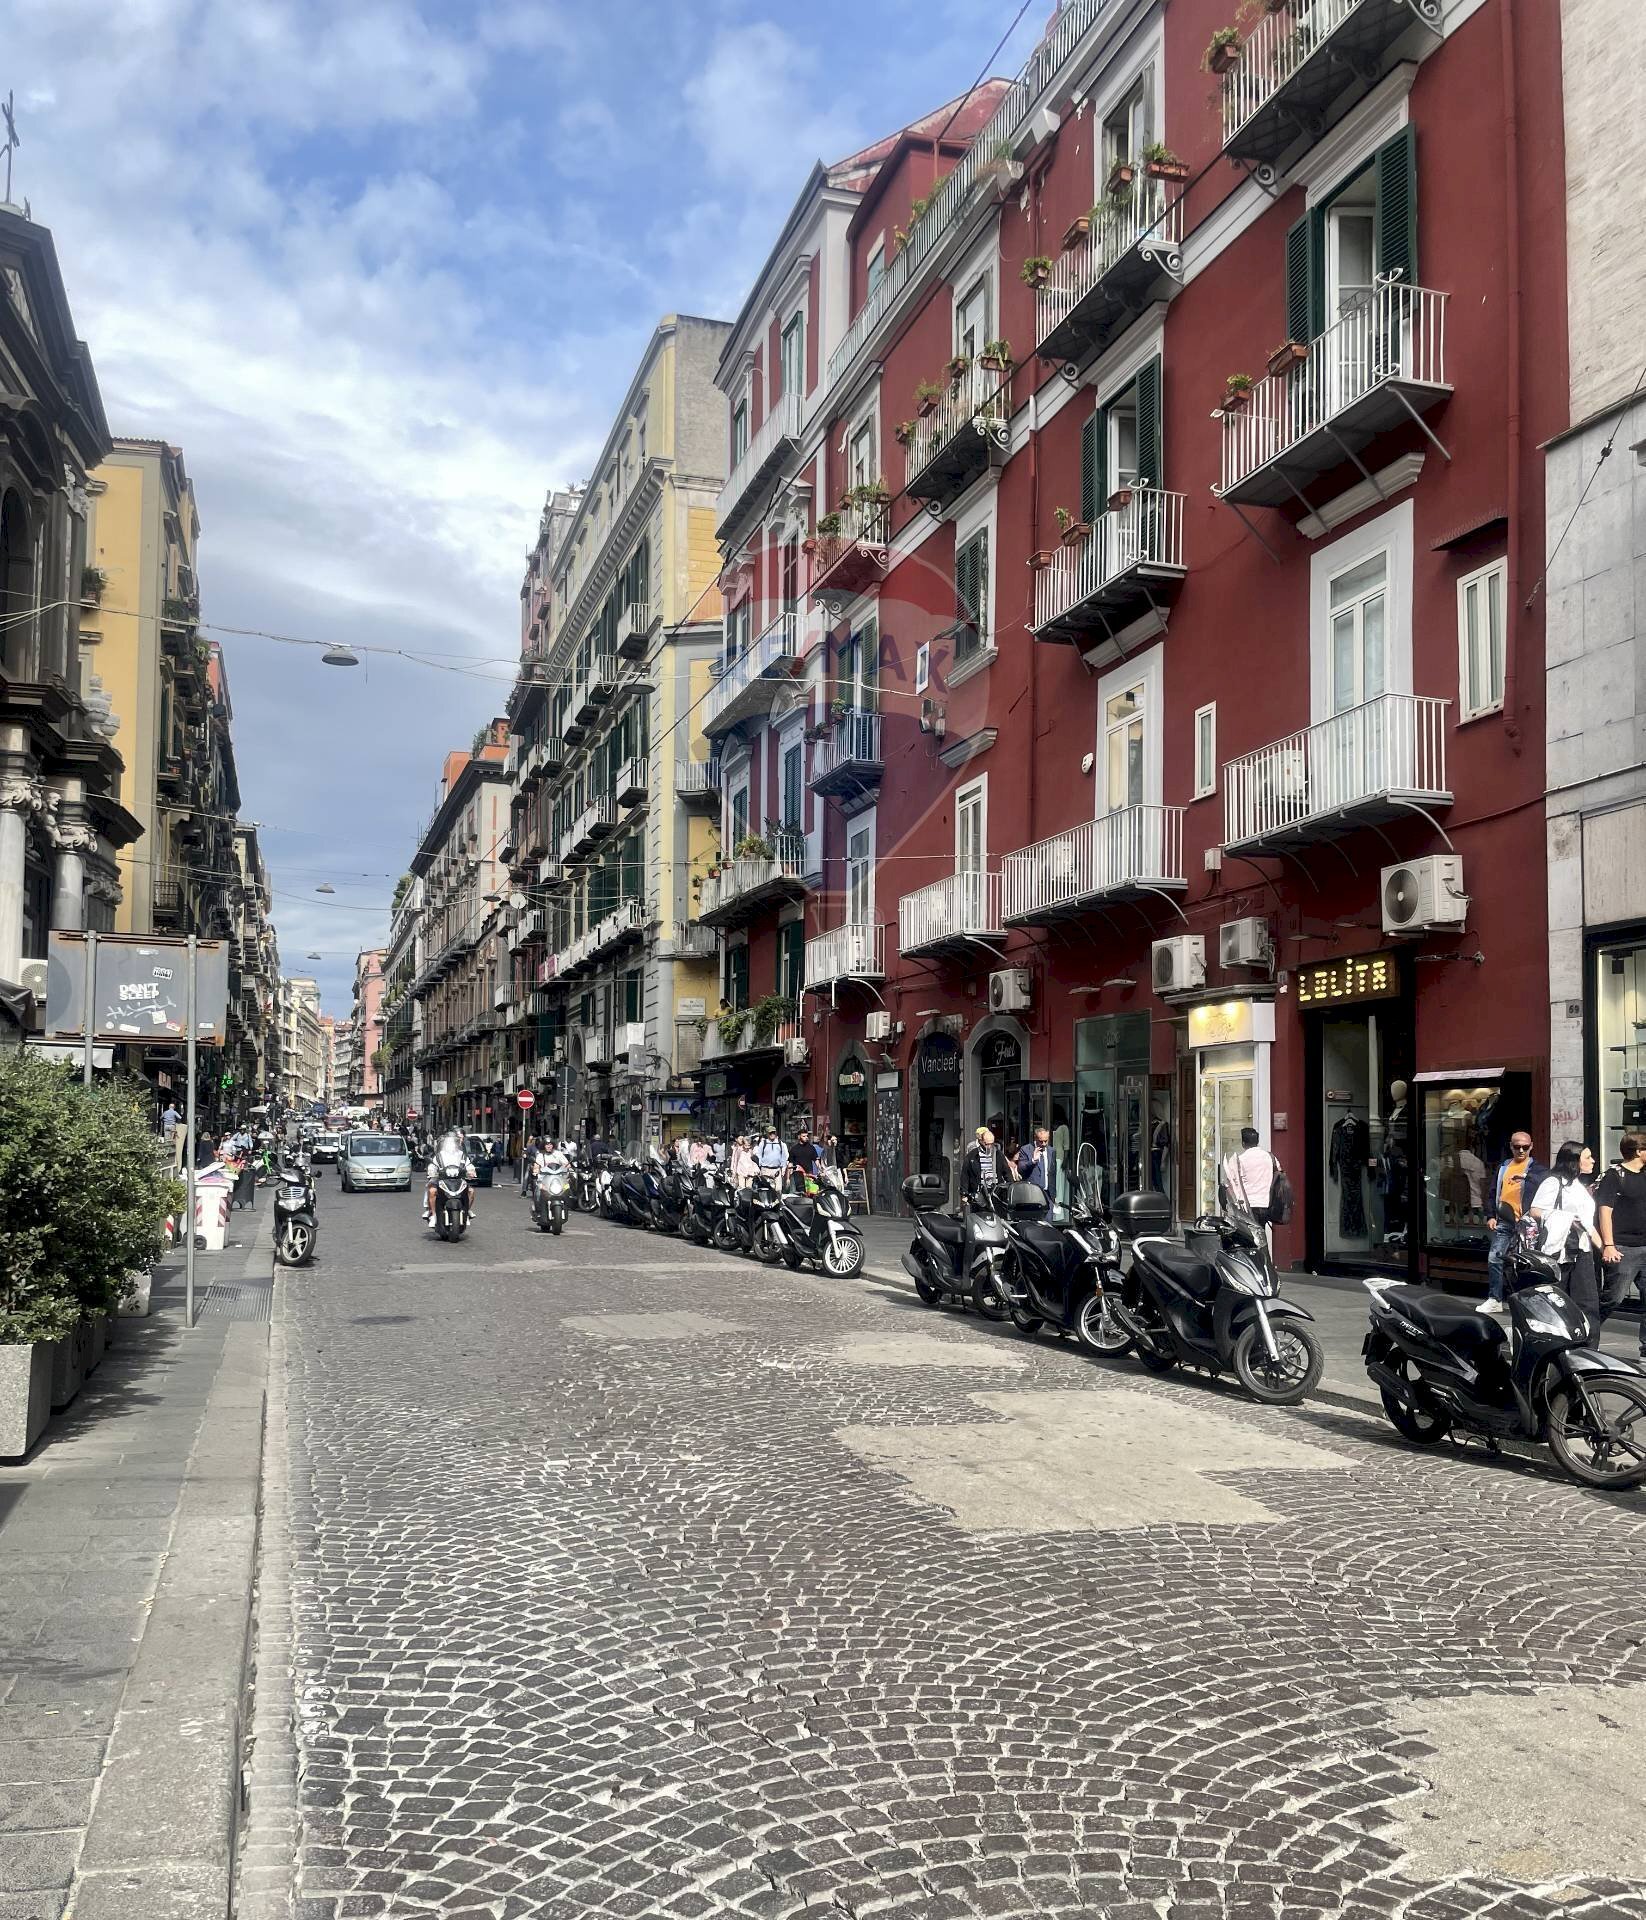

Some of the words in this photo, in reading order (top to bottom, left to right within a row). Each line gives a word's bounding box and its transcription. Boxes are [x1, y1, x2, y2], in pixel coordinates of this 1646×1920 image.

[120, 983, 159, 993] DON'T
[120, 991, 159, 1000] SLEEP
[921, 1051, 957, 1073] Vancleef
